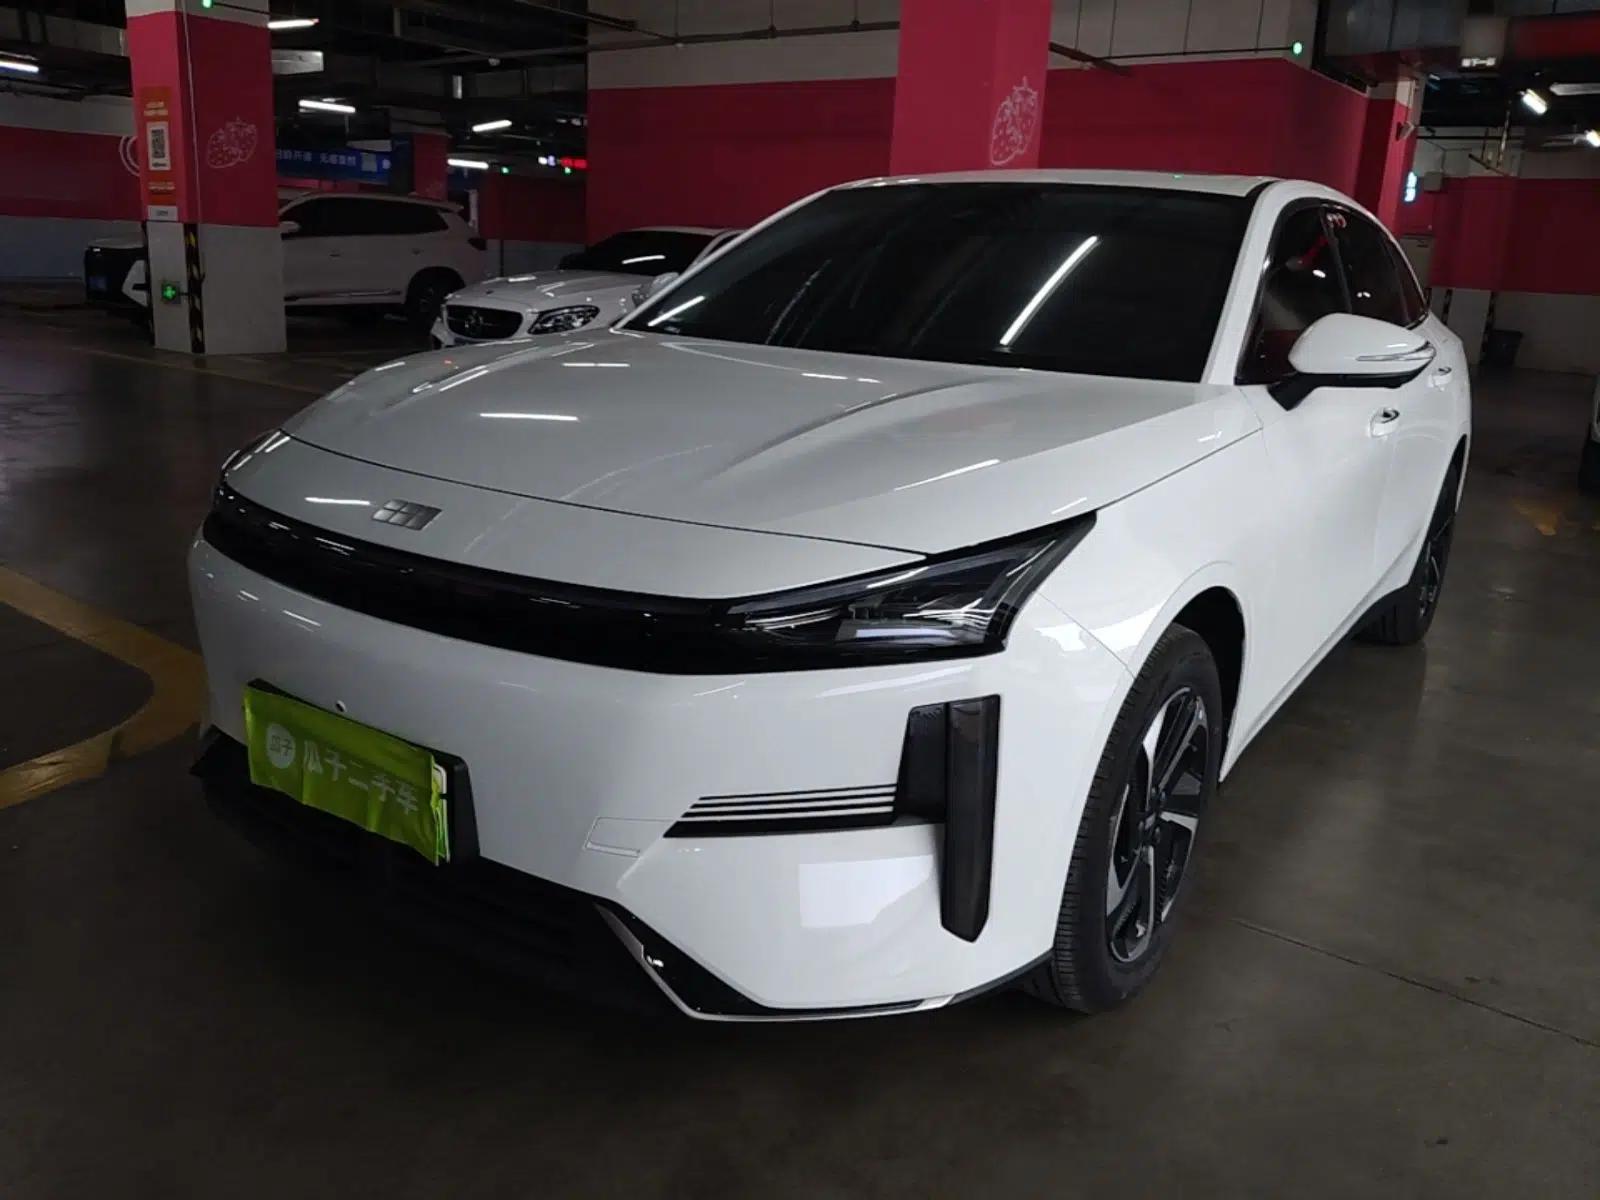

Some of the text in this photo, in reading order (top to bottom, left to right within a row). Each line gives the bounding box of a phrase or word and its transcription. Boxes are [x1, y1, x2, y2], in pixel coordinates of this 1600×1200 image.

[304, 740, 418, 815] 瓜子二手车
